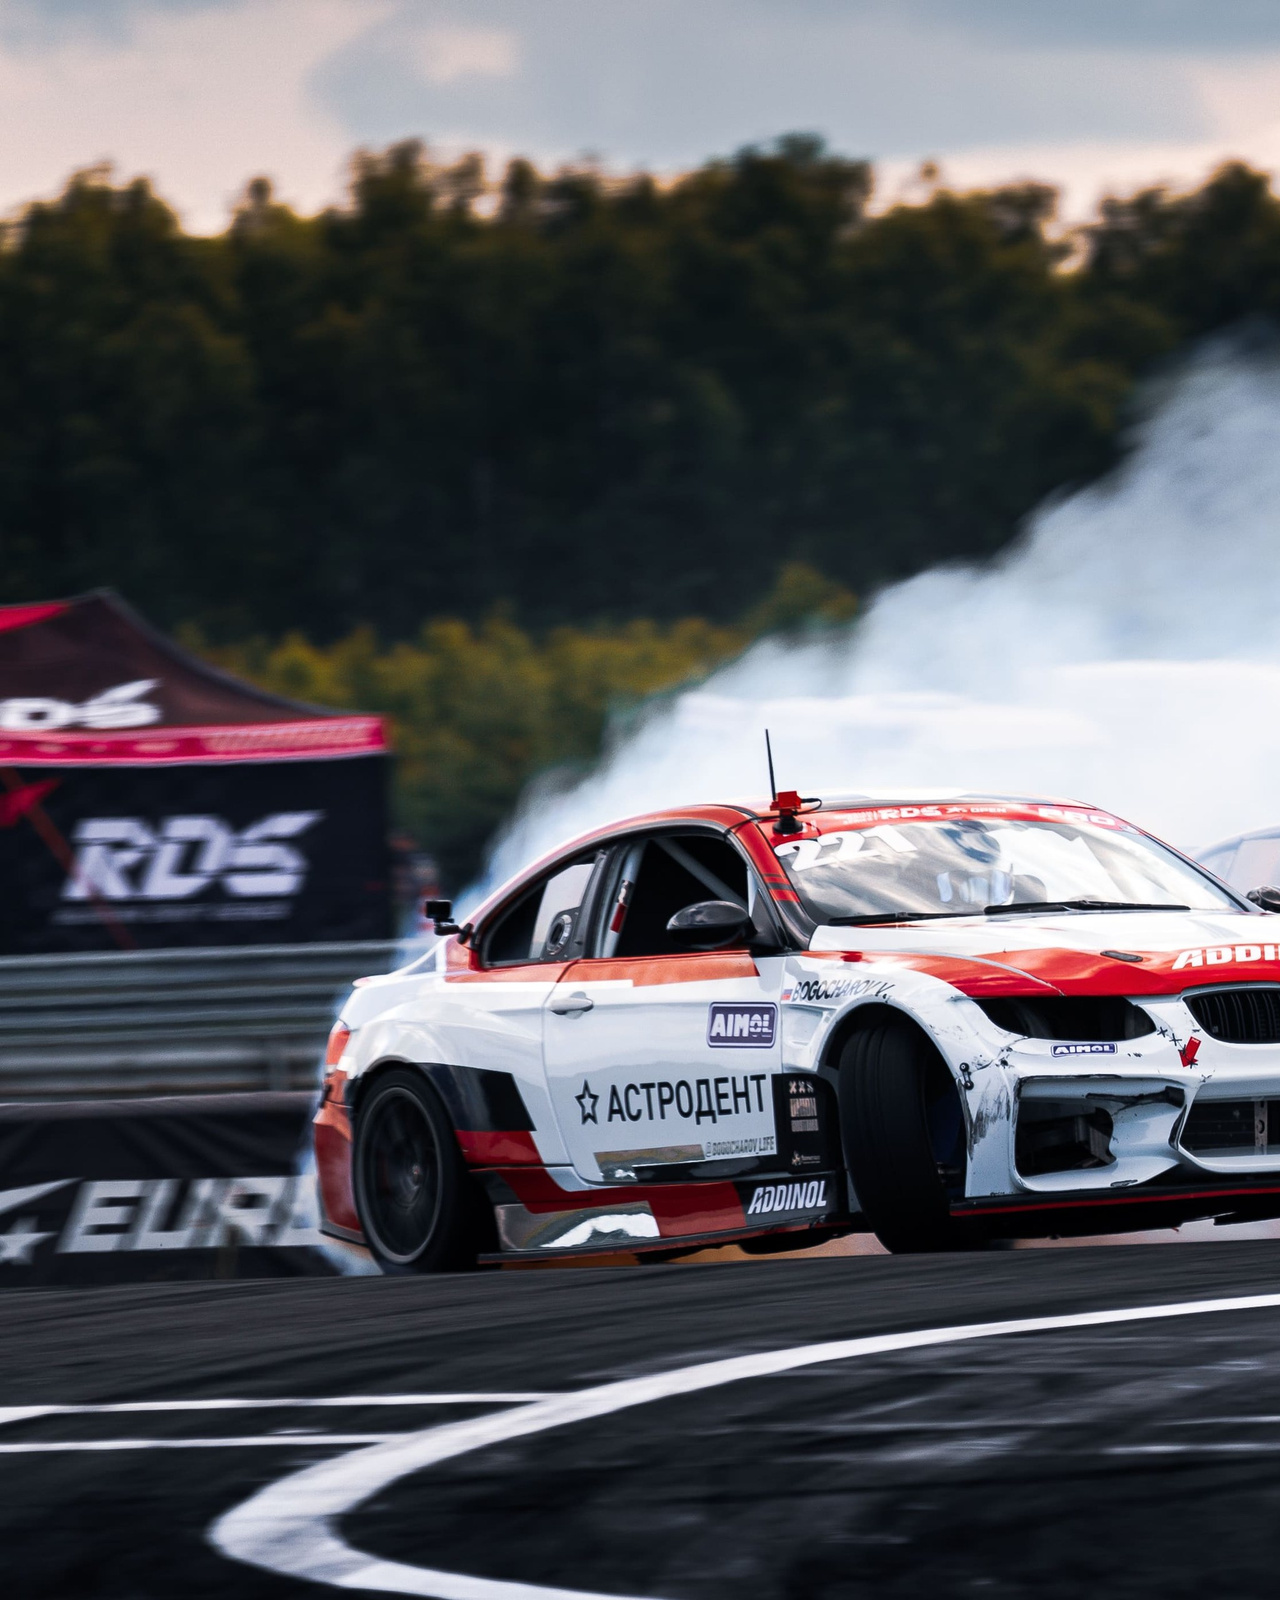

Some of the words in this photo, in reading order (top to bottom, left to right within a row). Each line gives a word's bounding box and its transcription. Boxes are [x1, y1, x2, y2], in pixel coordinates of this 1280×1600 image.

[0, 678, 162, 732] DS
[879, 806, 943, 820] RDS
[1038, 808, 1115, 826] PRO
[62, 810, 328, 899] RDS
[792, 980, 881, 1002] BOGOCHAROV
[710, 1013, 773, 1038] AIMOL
[1055, 1045, 1114, 1054] AIMOL
[607, 1073, 767, 1125] АСТРОДЕНТ
[748, 1181, 828, 1214] ADDINOL
